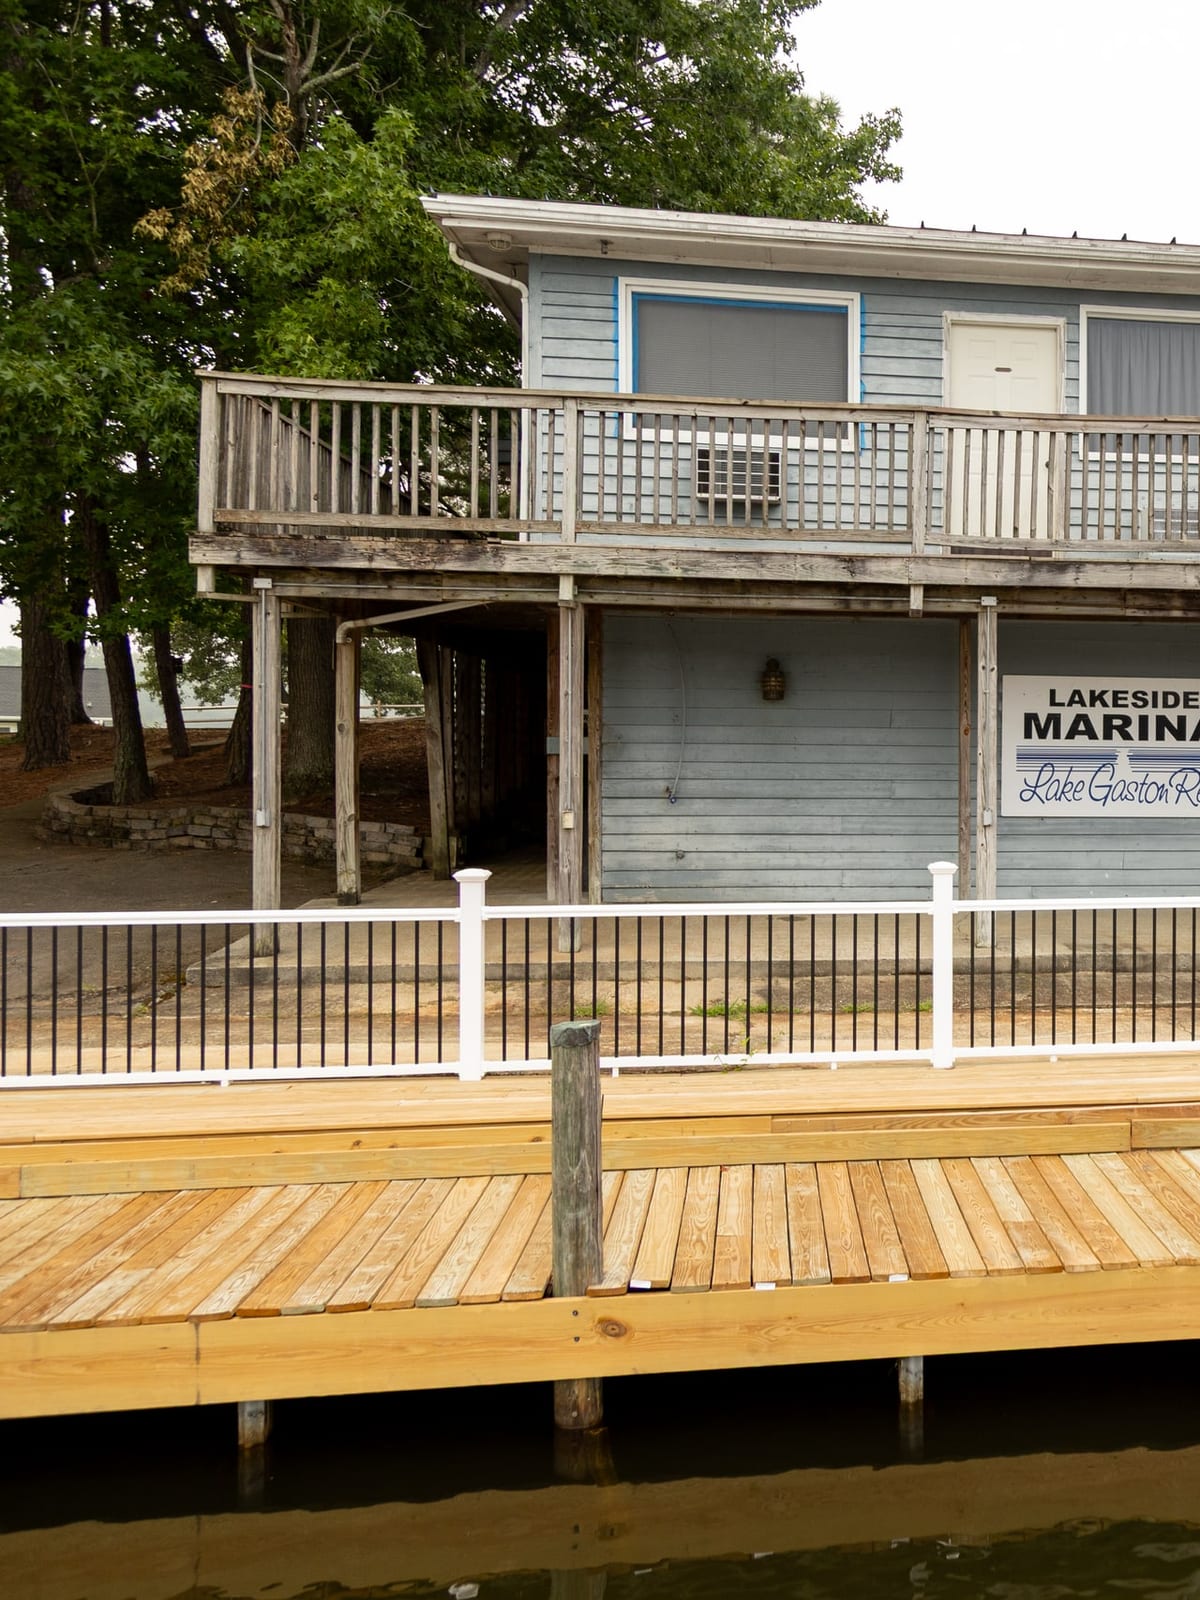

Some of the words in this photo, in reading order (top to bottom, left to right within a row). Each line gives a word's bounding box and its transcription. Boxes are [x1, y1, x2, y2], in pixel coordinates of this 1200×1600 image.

[1049, 688, 1200, 709] LAKESIDE
[1019, 763, 1085, 804] Lake
[1088, 763, 1169, 807] Gaston
